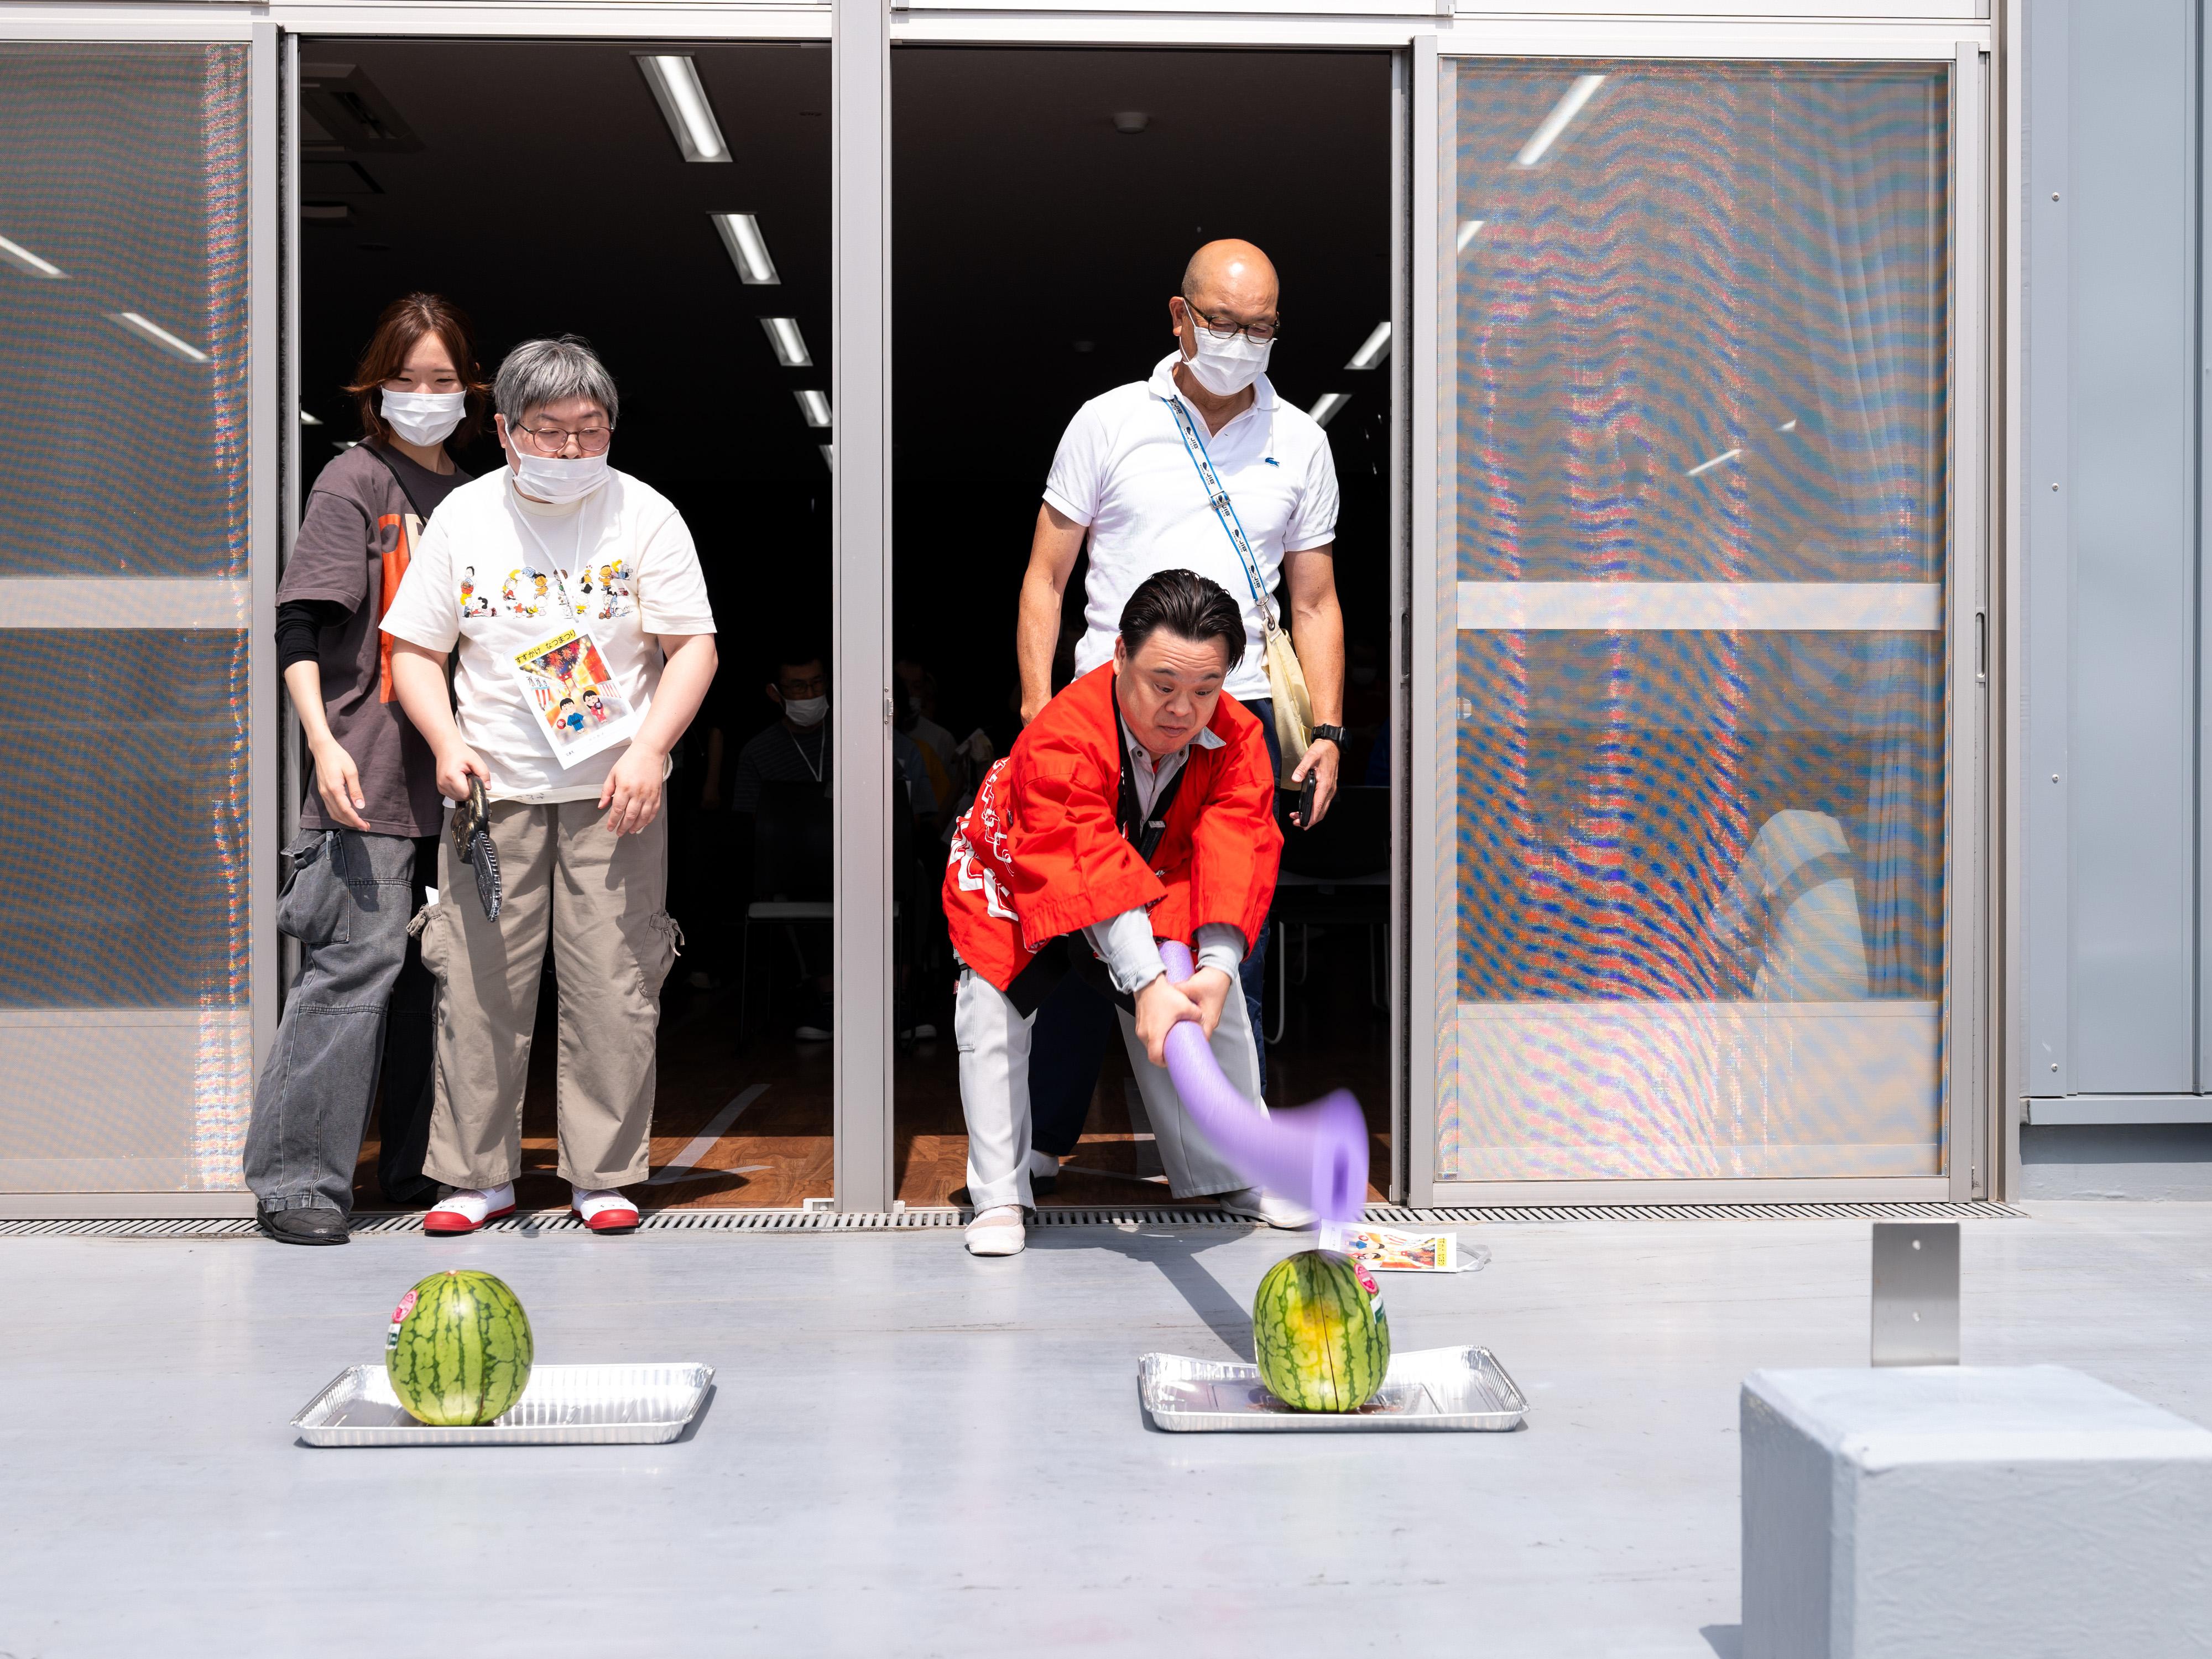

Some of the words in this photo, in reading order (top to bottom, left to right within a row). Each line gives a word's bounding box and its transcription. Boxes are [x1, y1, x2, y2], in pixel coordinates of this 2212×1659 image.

[1222, 504, 1230, 517] JIB
[545, 629, 576, 649] なつまつり
